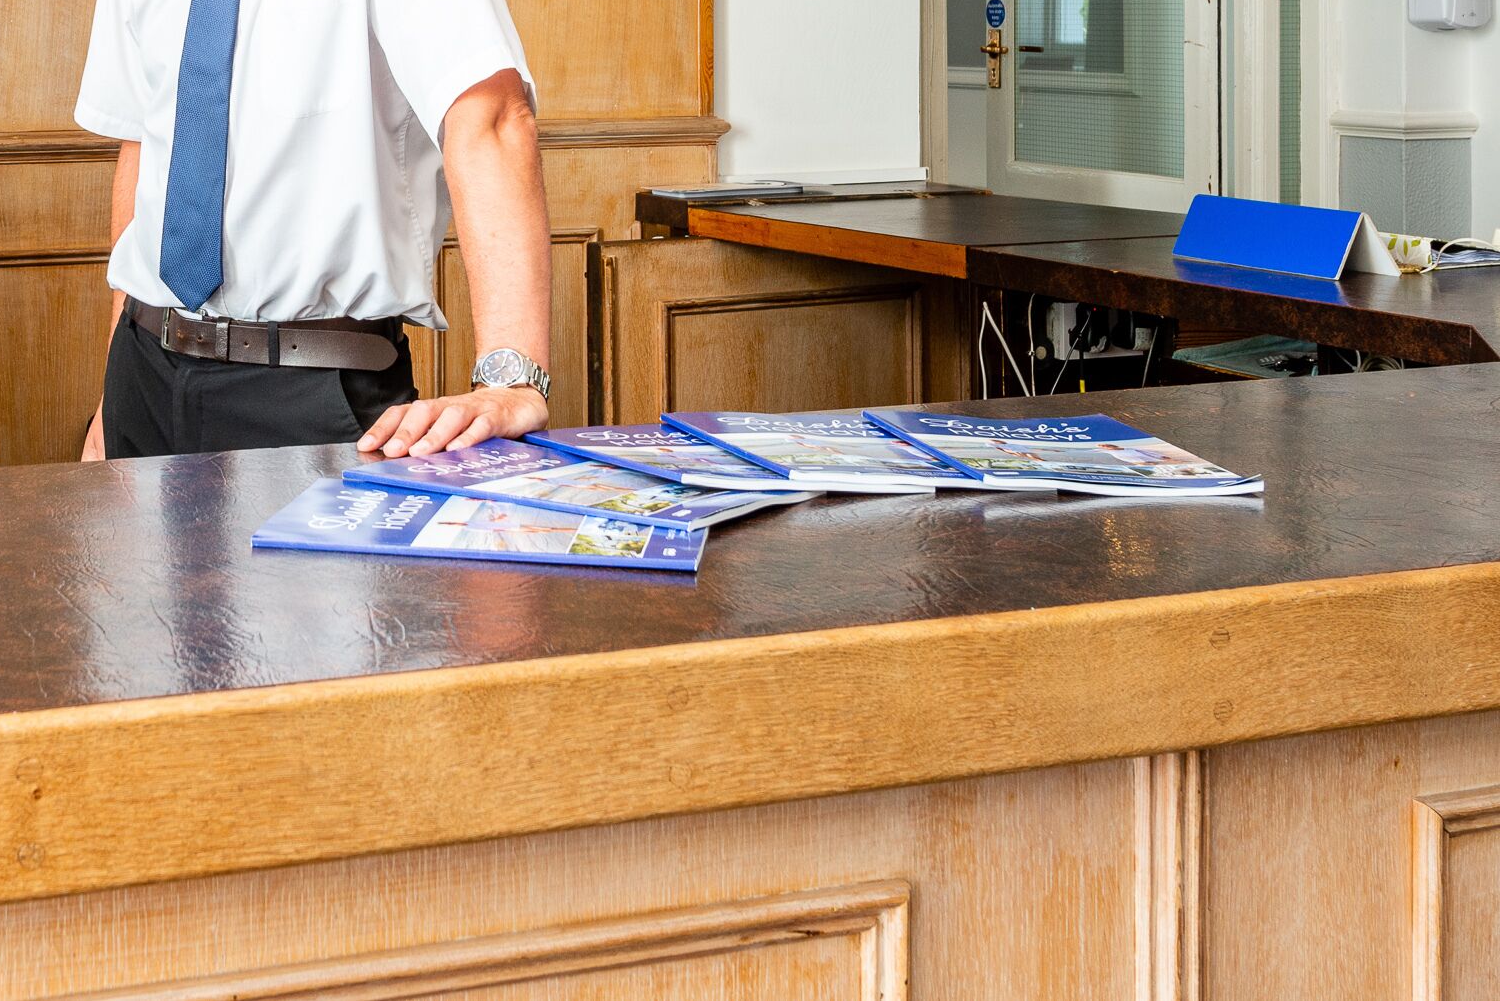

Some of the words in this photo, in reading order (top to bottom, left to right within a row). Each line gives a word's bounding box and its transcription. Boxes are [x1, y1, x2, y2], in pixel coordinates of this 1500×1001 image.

[717, 416, 880, 429] Daish's
[919, 417, 1089, 434] Daish's
[746, 425, 884, 437] Holidays
[948, 428, 1092, 442] Holidays
[308, 489, 388, 531] Daish's
[372, 494, 432, 530] Holidays
